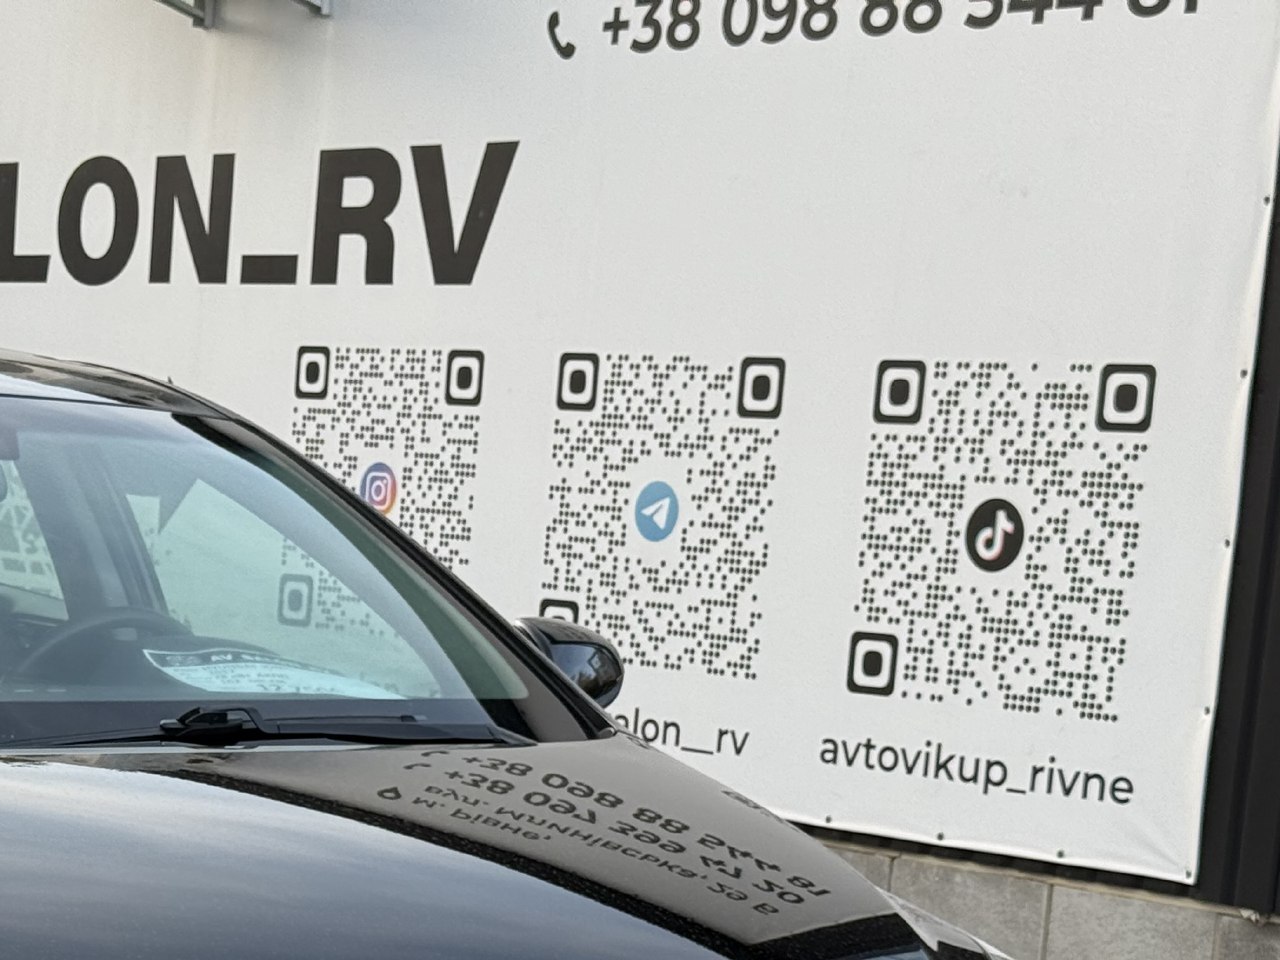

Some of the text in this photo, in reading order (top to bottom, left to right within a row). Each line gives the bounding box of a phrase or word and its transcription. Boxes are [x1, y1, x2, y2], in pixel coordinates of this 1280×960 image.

[602, 0, 701, 53] +38
[721, 0, 838, 47] 098
[819, 737, 1134, 804] avtovikup_rivne
